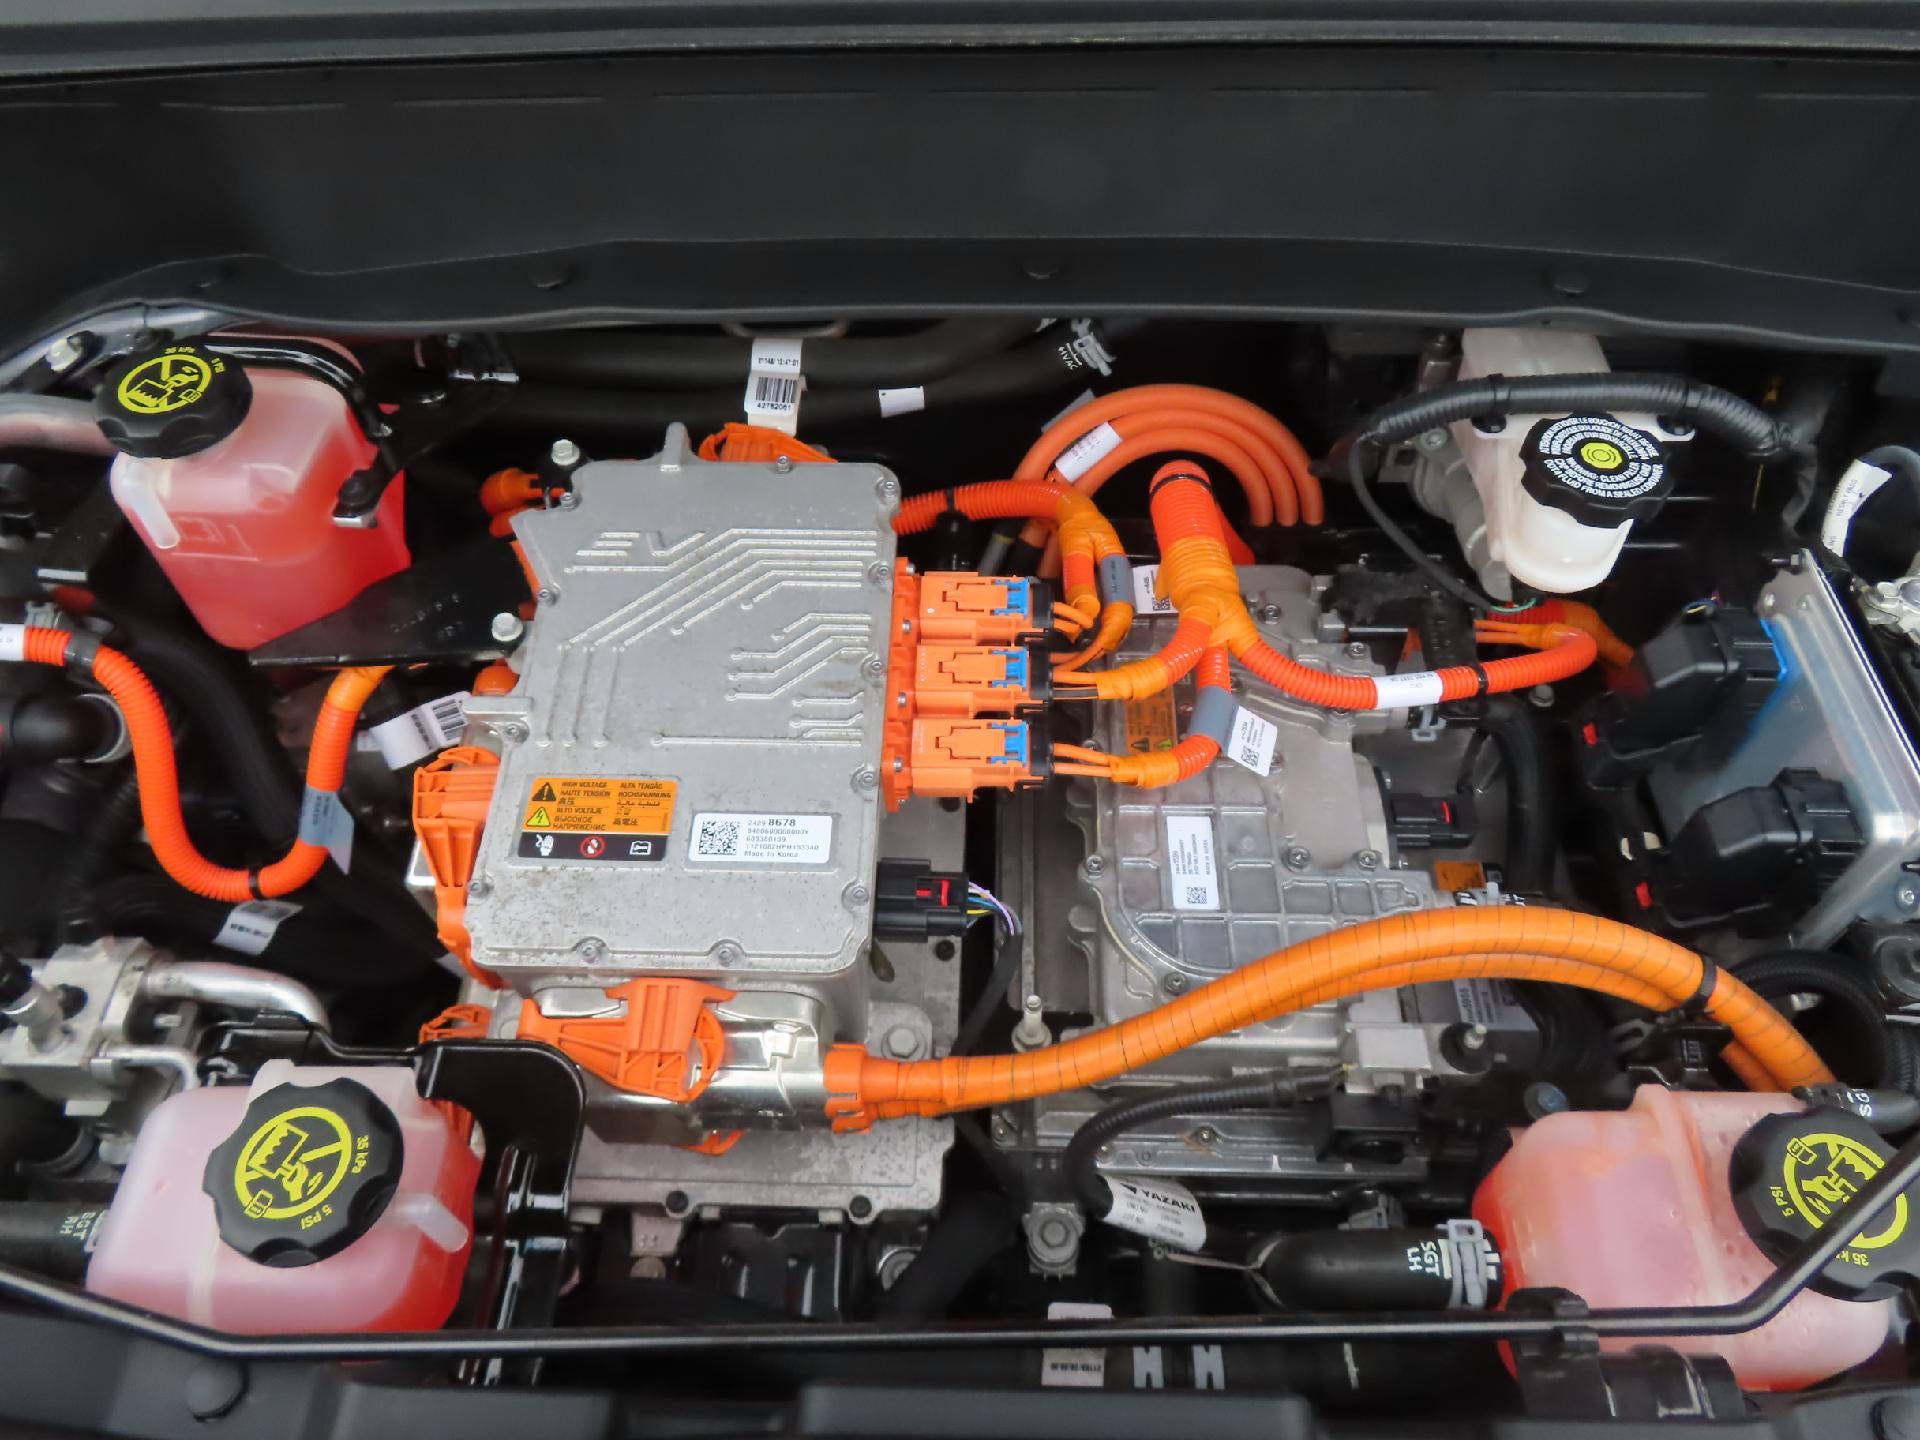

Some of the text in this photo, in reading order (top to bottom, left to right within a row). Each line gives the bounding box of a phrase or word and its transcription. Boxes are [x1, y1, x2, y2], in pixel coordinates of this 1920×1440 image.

[1587, 418, 1620, 429] BOUCHON
[1619, 425, 1641, 439] AVANT
[1557, 473, 1582, 489] FLUID
[1579, 484, 1606, 497] FROM
[1612, 487, 1646, 498] SEALED
[1564, 468, 1594, 487] BEFORE
[1599, 474, 1629, 483] CLEAN
[582, 790, 611, 798] TENSION
[768, 818, 797, 828] 8678
[351, 1135, 369, 1174] 35 kPa
[1140, 1189, 1196, 1213] YAZAKI
[1769, 1186, 1786, 1207] PSI
[301, 1203, 333, 1230] 5 PSI
[1406, 1246, 1423, 1271] LH
[1419, 1240, 1440, 1278] SGT
